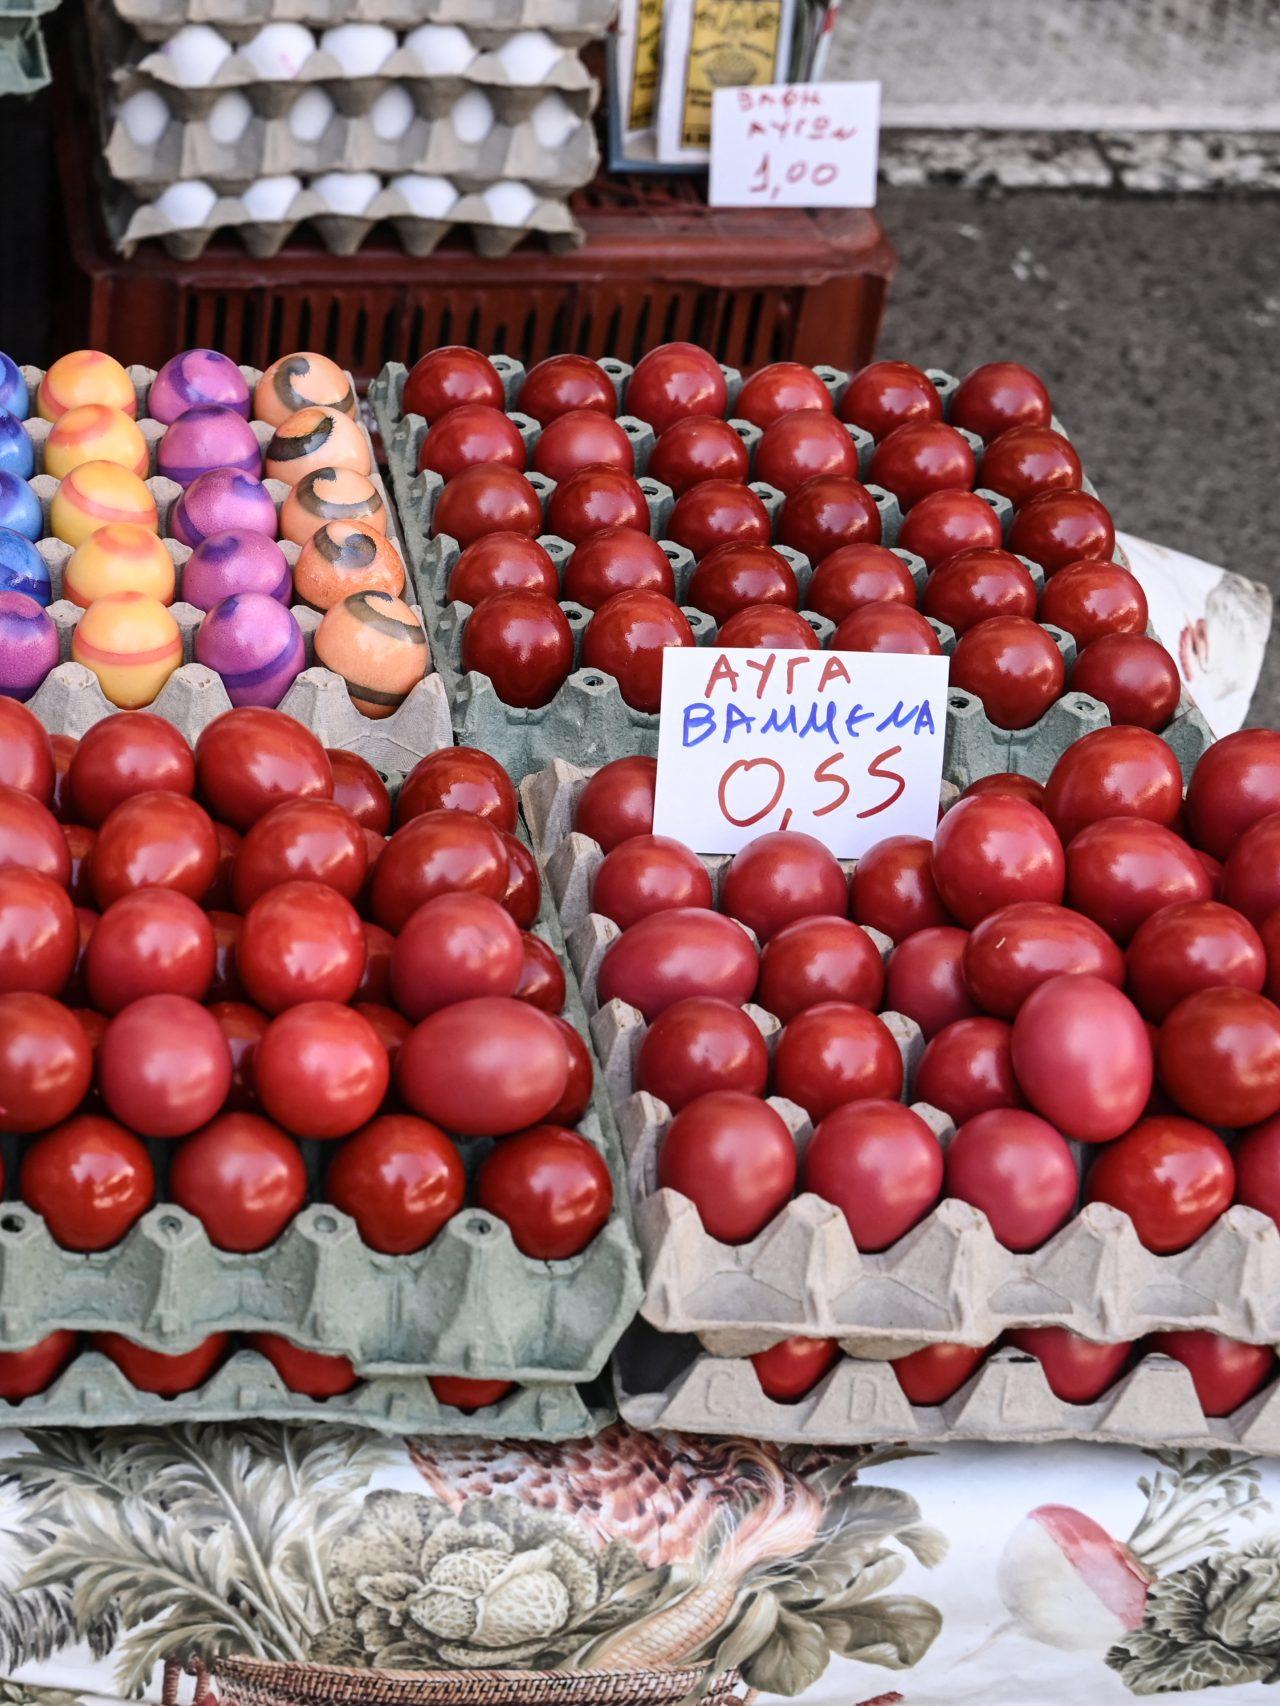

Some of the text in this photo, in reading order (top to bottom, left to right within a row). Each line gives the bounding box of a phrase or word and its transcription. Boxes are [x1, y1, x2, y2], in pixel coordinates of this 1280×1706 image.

[748, 152, 840, 200] 1,00
[703, 652, 852, 700] ΑΥΓΑ
[681, 699, 936, 748] ΒΑΜΜΕΝΑ
[717, 744, 907, 832] 0,55
